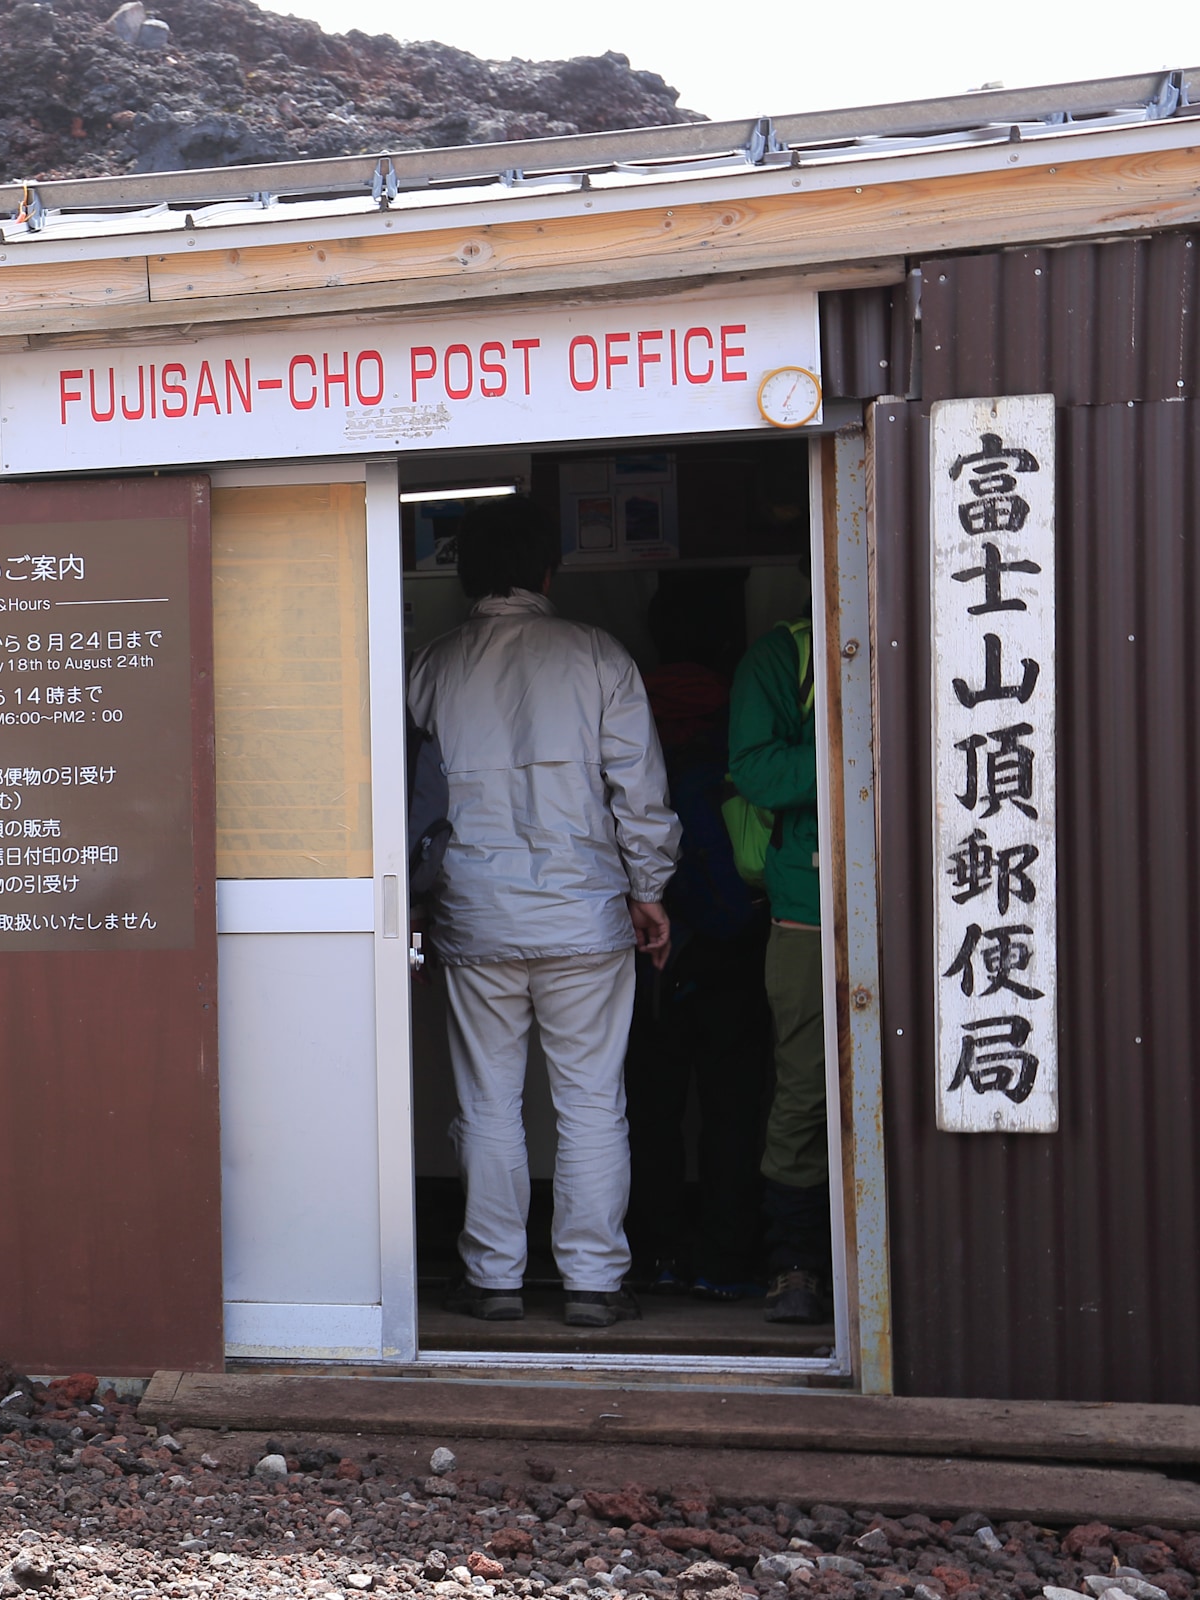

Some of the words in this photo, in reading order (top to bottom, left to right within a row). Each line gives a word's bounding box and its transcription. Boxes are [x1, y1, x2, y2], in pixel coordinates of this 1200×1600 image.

[59, 349, 384, 425] FUJISAN-CHO
[410, 335, 541, 403] POST
[568, 323, 749, 392] OFFICE
[7, 658, 43, 672] 18th
[46, 658, 61, 671] to
[64, 656, 113, 671] August
[116, 653, 154, 669] 24th
[944, 432, 1045, 1104] 富士山頂郵便局
